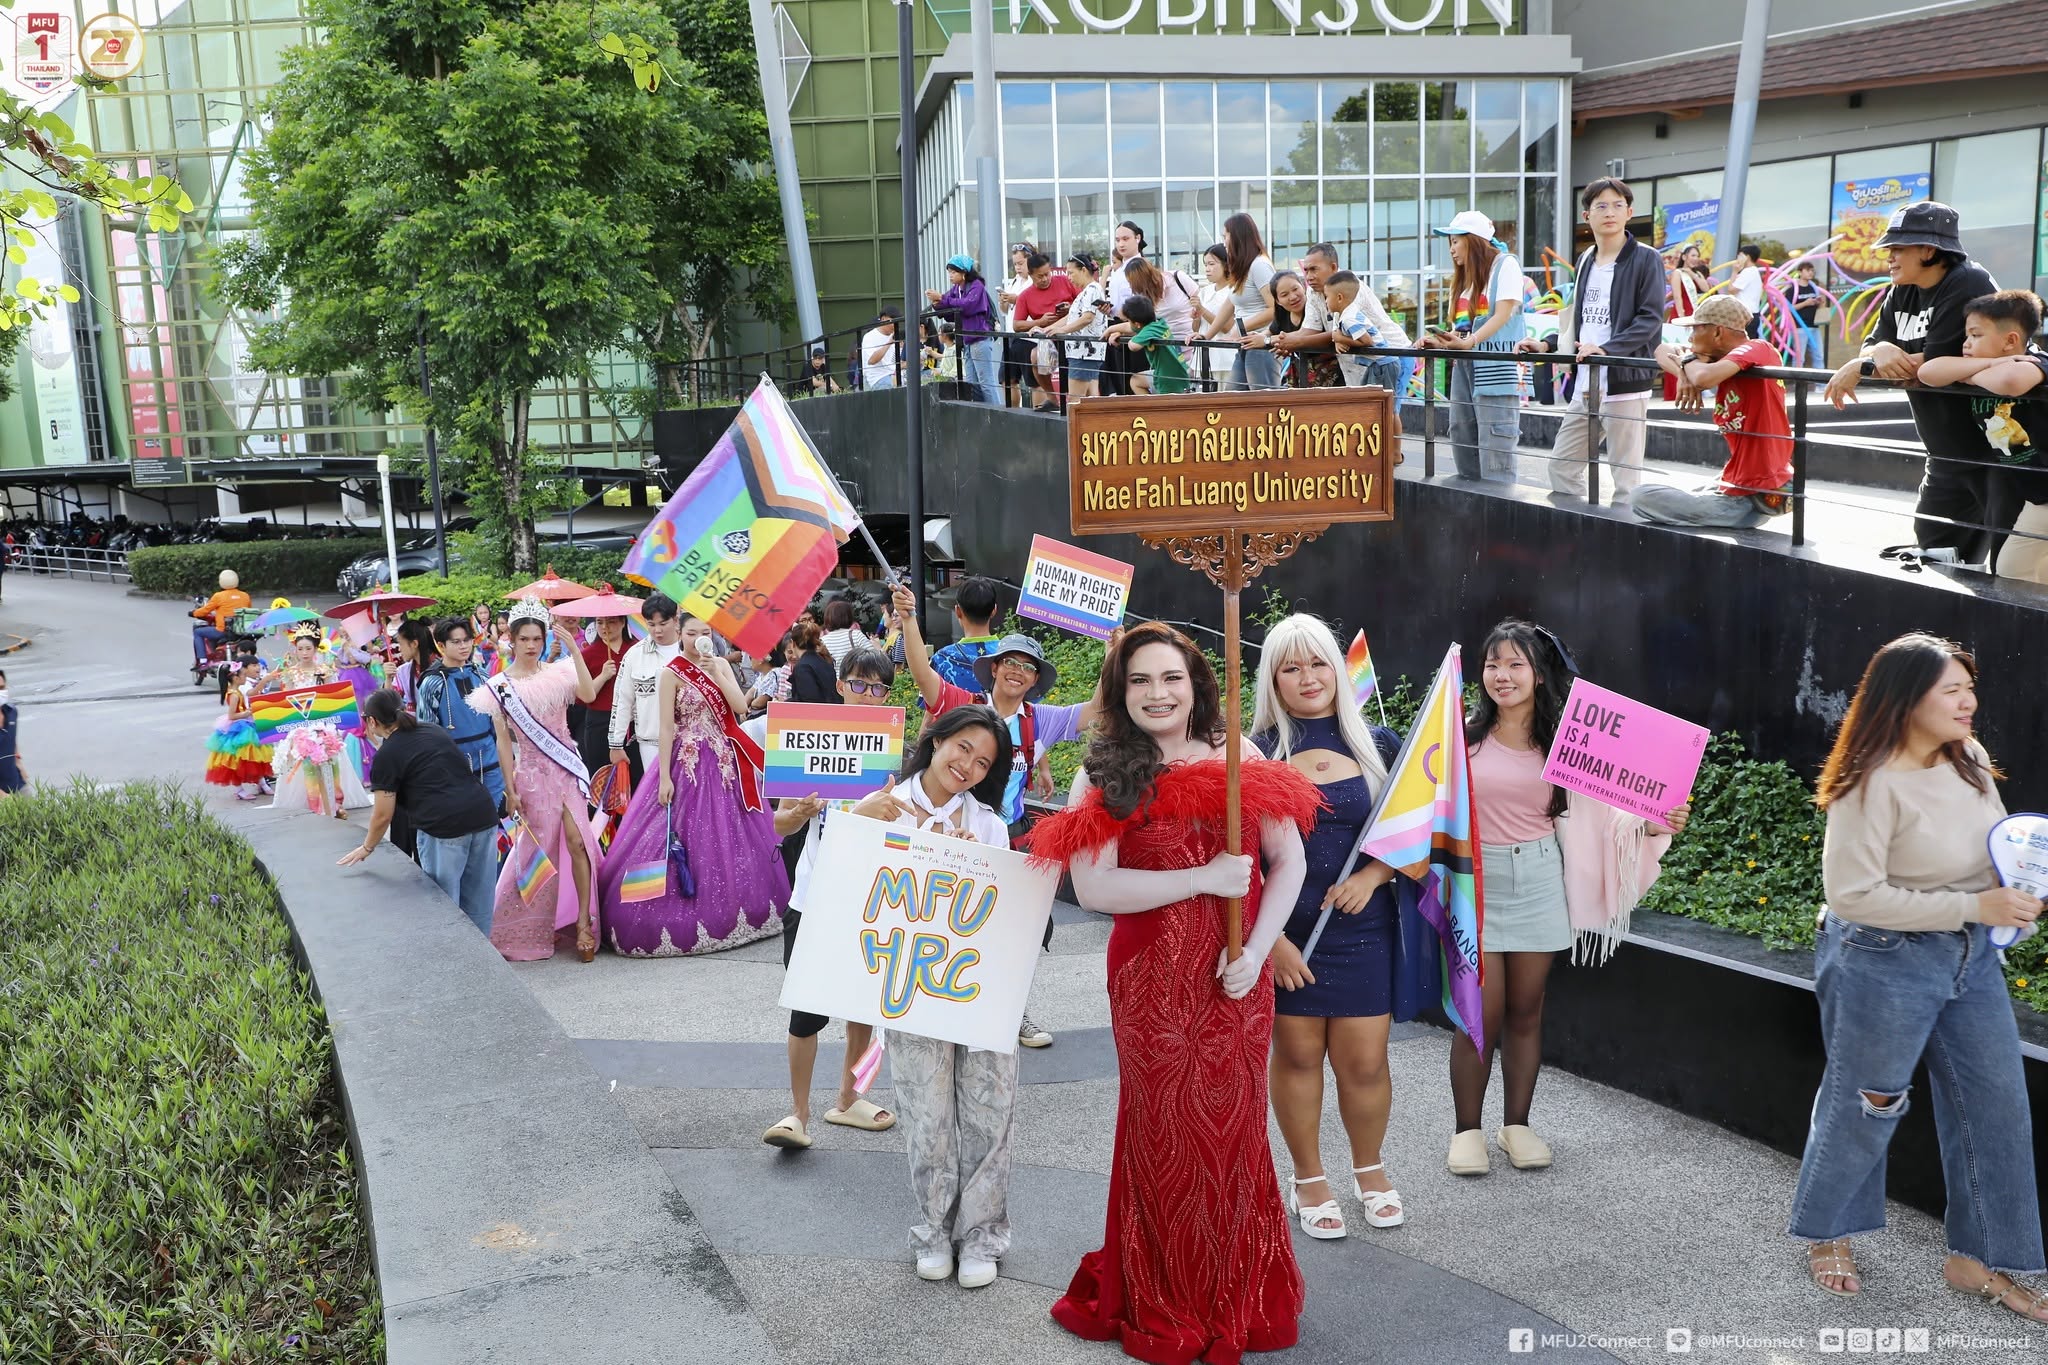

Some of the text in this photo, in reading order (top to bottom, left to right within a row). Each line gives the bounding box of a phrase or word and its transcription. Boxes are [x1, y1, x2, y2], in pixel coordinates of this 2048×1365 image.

[1081, 408, 1381, 466] มหาวิทยาลัยแม่ฟ้าหลวง
[1083, 469, 1374, 512] Mae Fah Luang University
[671, 563, 734, 608] PRIDE
[684, 549, 784, 622] BANGKOK
[1033, 579, 1116, 617] ARE MY PRIDE
[1035, 561, 1121, 601] HUMAN RIGHTS
[1023, 605, 1048, 618] AMNESTY
[1048, 611, 1088, 630] INTERNATIONAL
[696, 675, 728, 716] Runner-up
[512, 705, 526, 725] QUEEN
[535, 730, 546, 741] THE
[1564, 725, 1590, 748] IS A
[1571, 698, 1626, 739] LOVE
[785, 732, 884, 752] RESIST WITH
[810, 756, 857, 774] PRIDE
[1556, 745, 1668, 801] HUMAN RIGHT
[1550, 769, 1584, 787] AMNESTY
[1584, 782, 1638, 809] INTERNATIONAL
[943, 848, 969, 863] Rights
[973, 858, 989, 868] Club
[863, 866, 998, 937] MFU
[1450, 914, 1479, 971] BANG
[860, 927, 981, 1019] HRC
